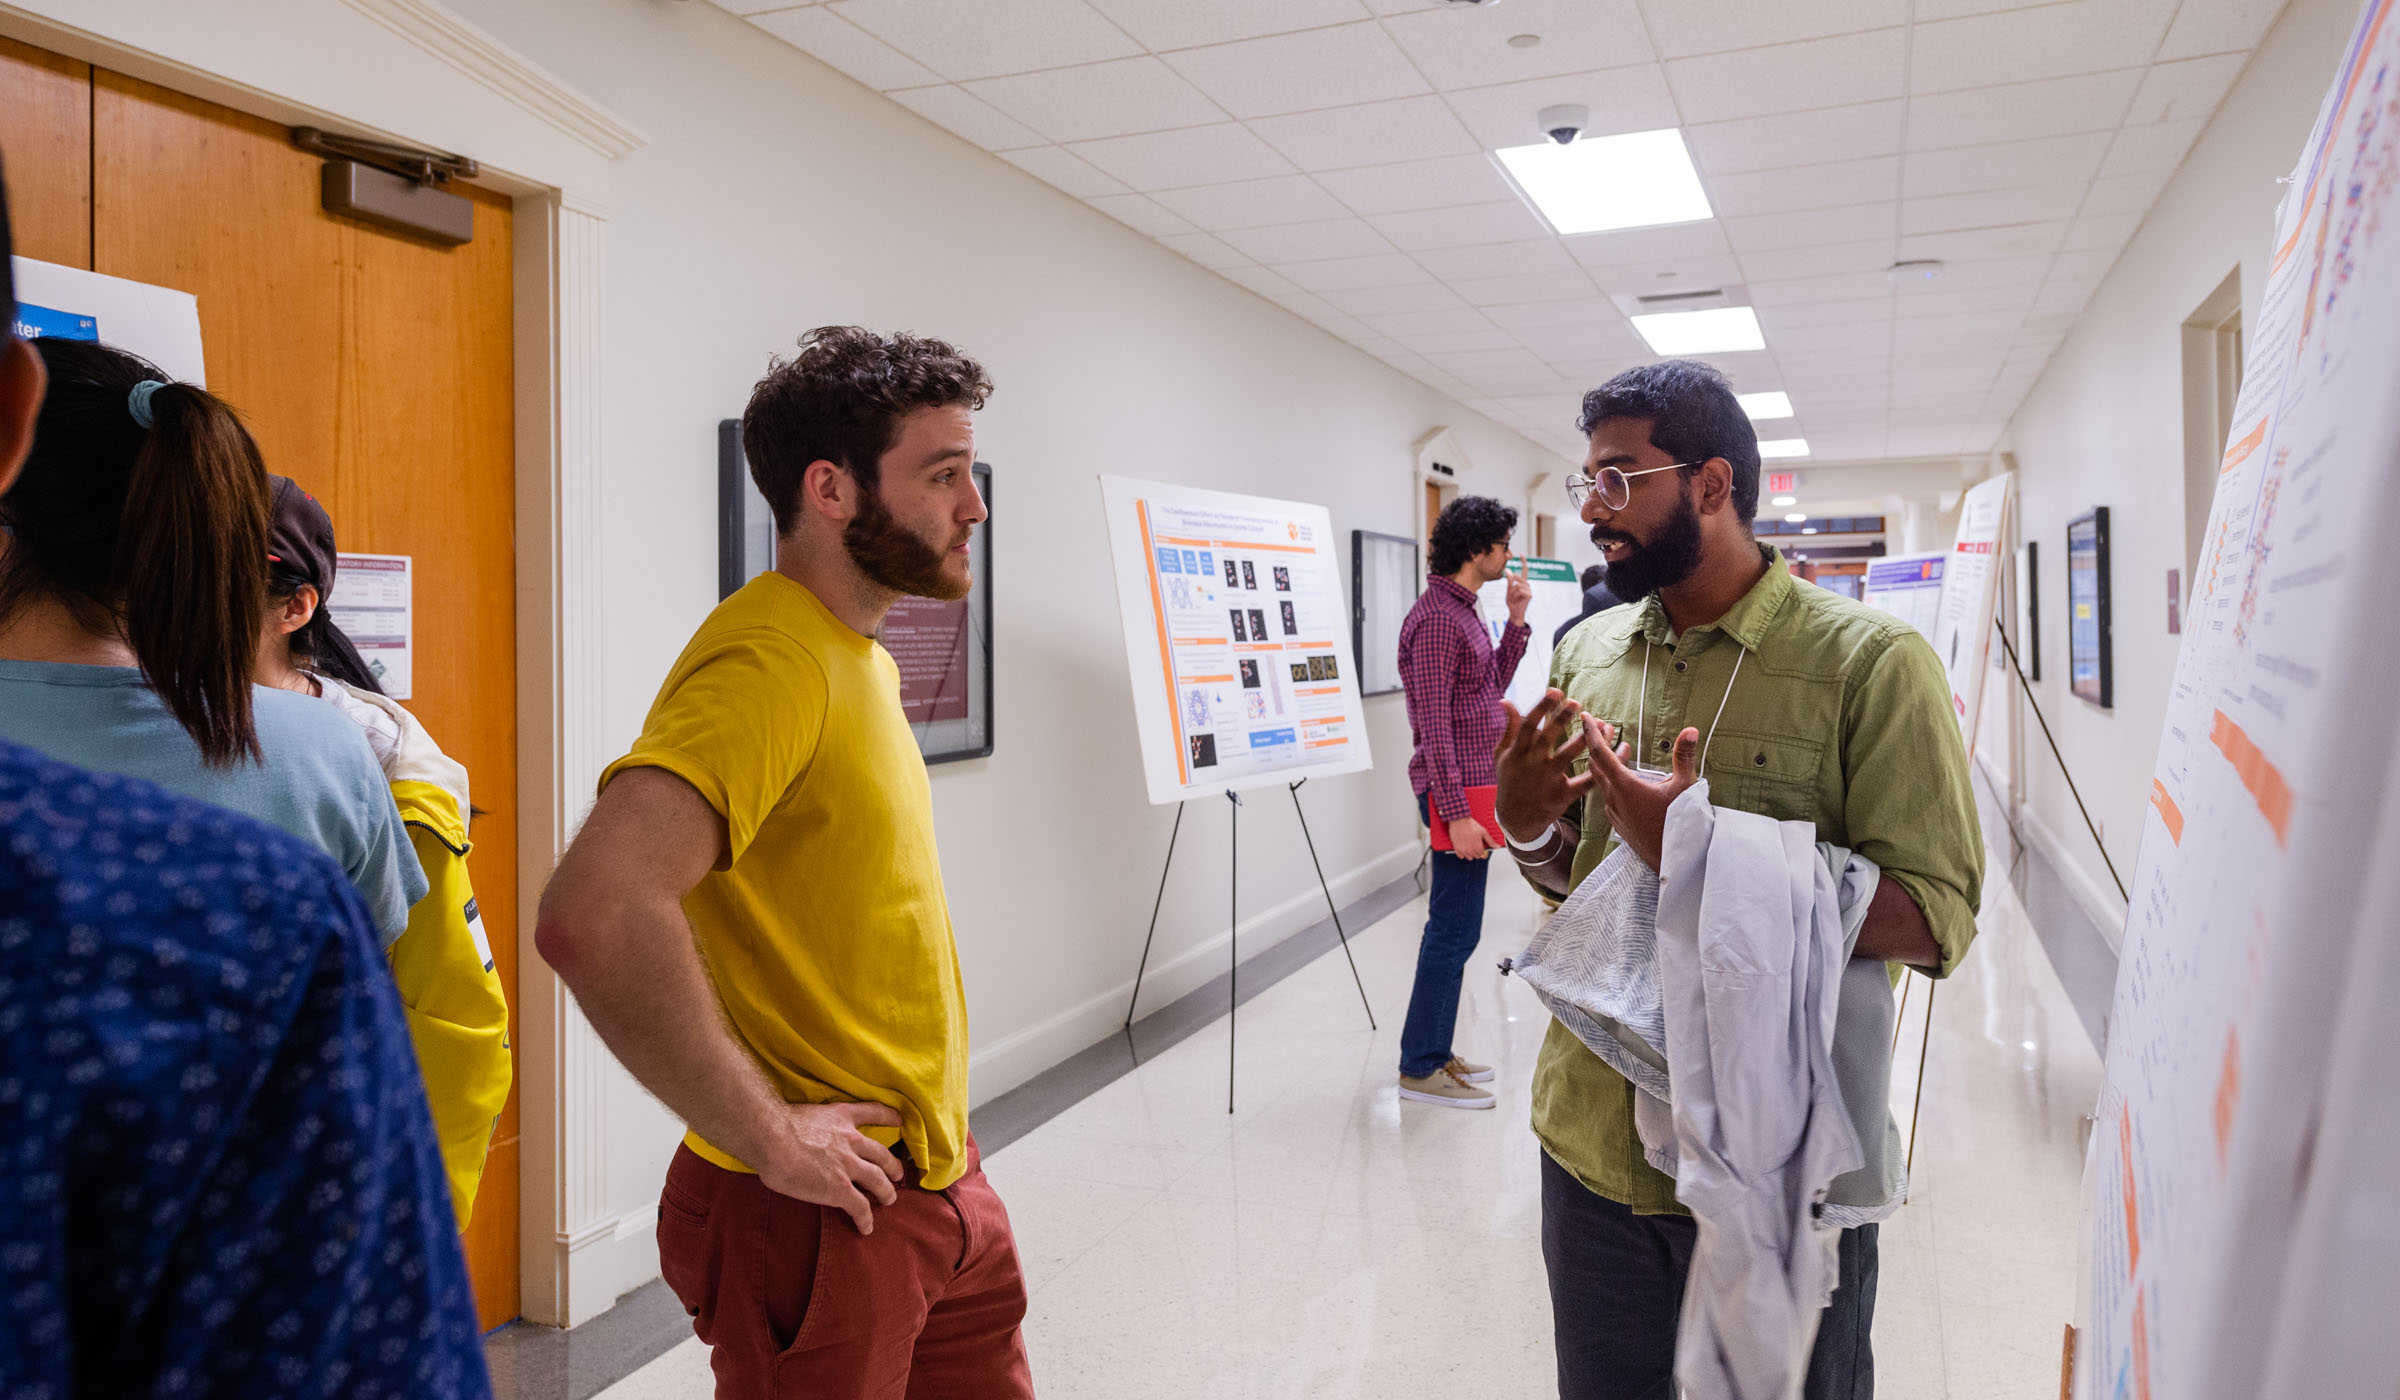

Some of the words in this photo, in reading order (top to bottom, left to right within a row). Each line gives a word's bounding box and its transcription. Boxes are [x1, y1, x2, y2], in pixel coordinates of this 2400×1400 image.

[11, 319, 43, 338] ter
[1770, 473, 1793, 492] EXIT
[363, 560, 403, 570] INFORMATION
